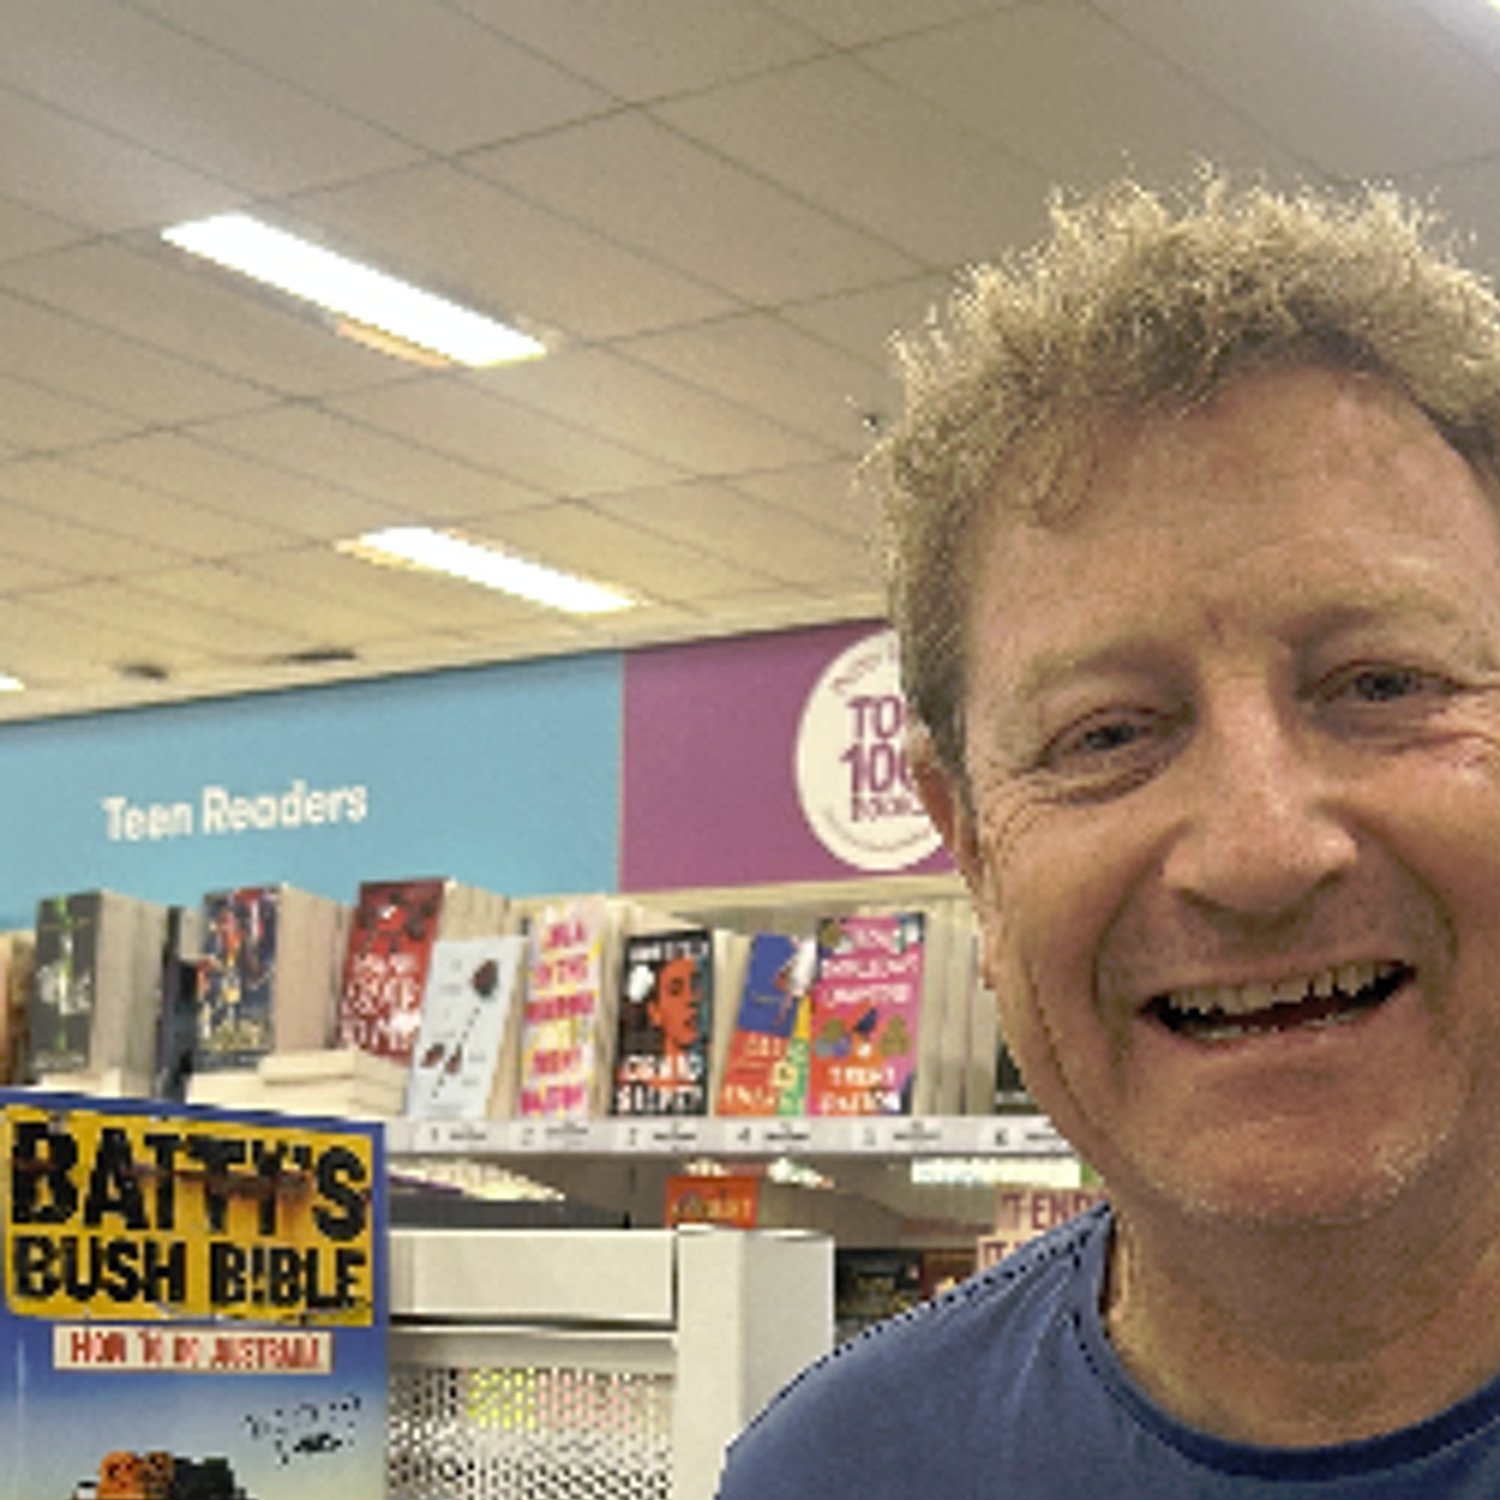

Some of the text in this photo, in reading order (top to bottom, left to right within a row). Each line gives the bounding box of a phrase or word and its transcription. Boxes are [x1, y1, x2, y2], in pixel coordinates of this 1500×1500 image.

[846, 694, 906, 741] TO
[102, 779, 369, 842] Teen Readers
[11, 1119, 368, 1242] BATTY'S
[13, 1233, 187, 1304] BUSH
